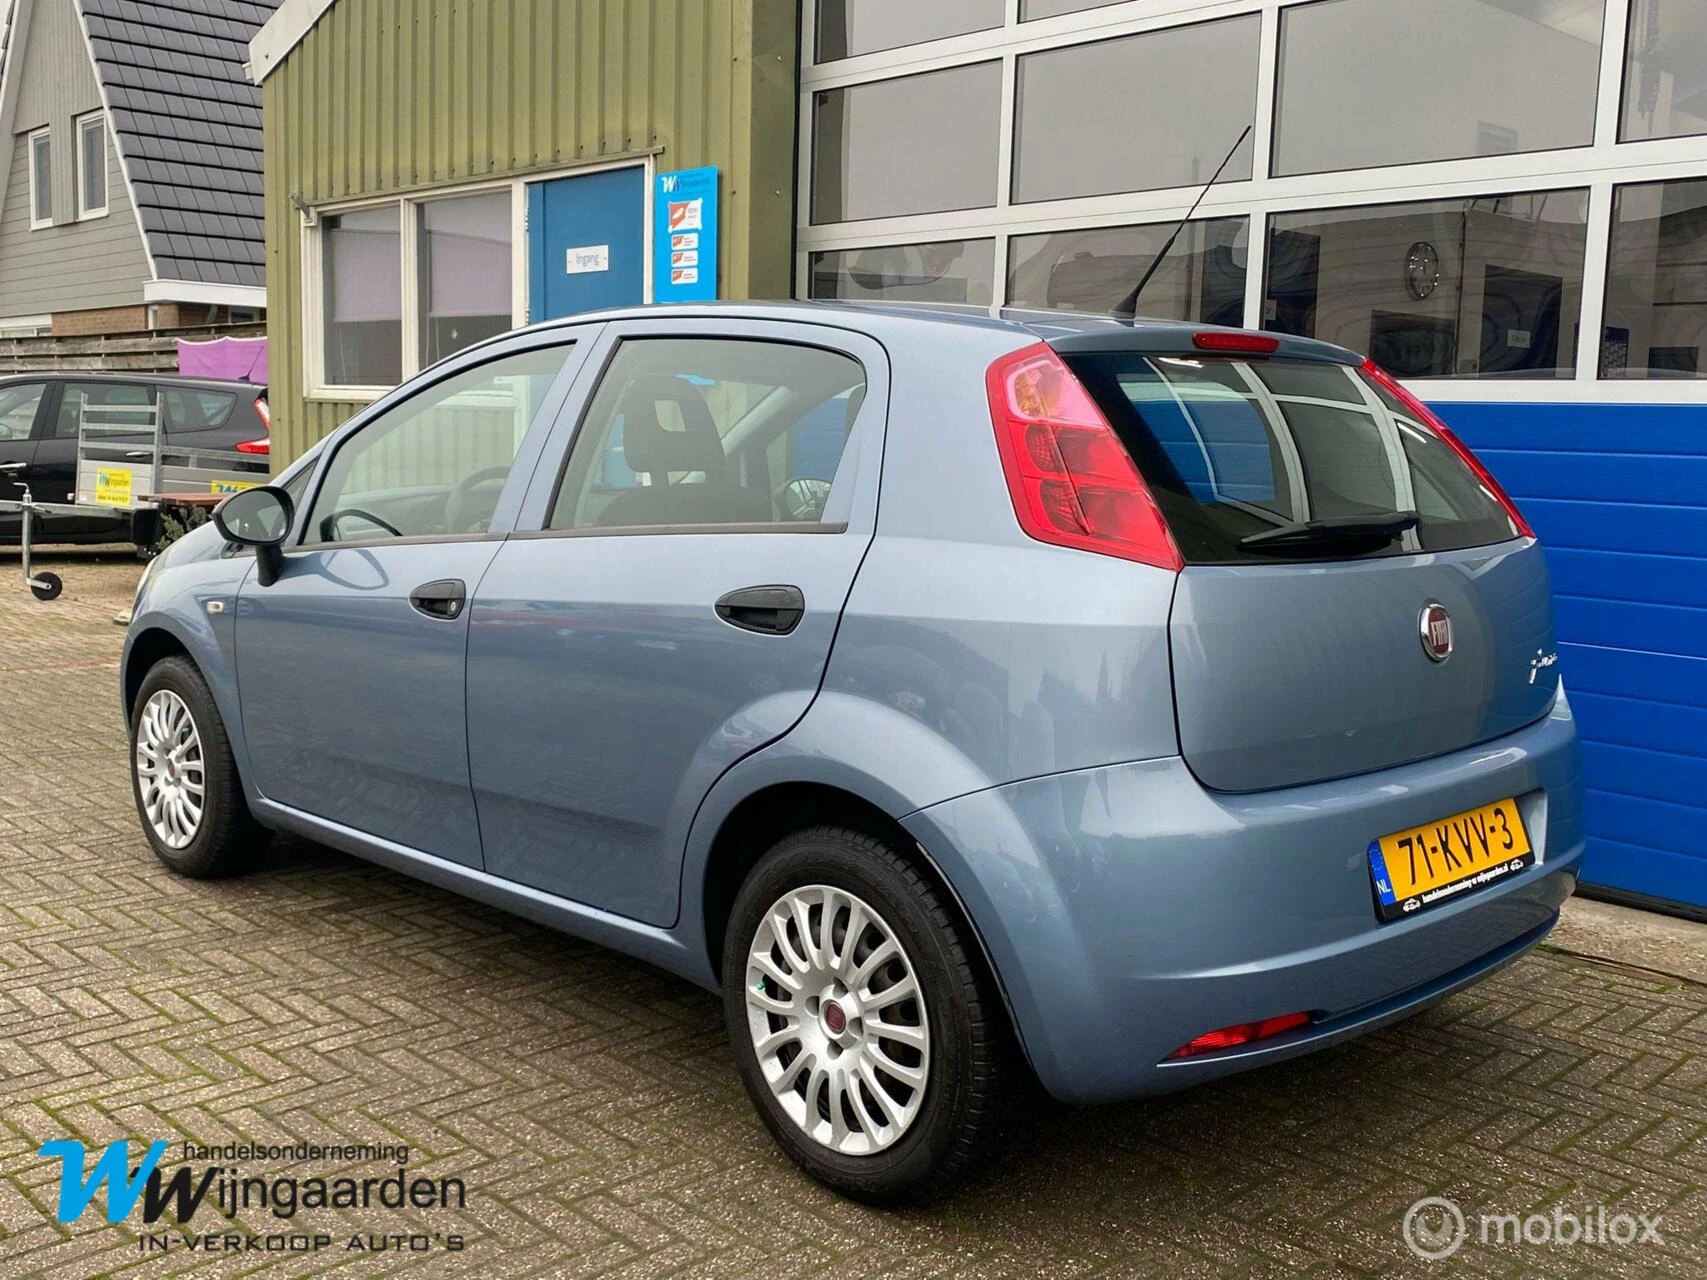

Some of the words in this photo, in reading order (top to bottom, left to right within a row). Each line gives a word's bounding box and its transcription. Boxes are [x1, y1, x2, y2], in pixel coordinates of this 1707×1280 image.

[1431, 619, 1448, 646] FIAT
[1397, 807, 1513, 886] 71-KVV-3
[1376, 880, 1391, 895] NL
